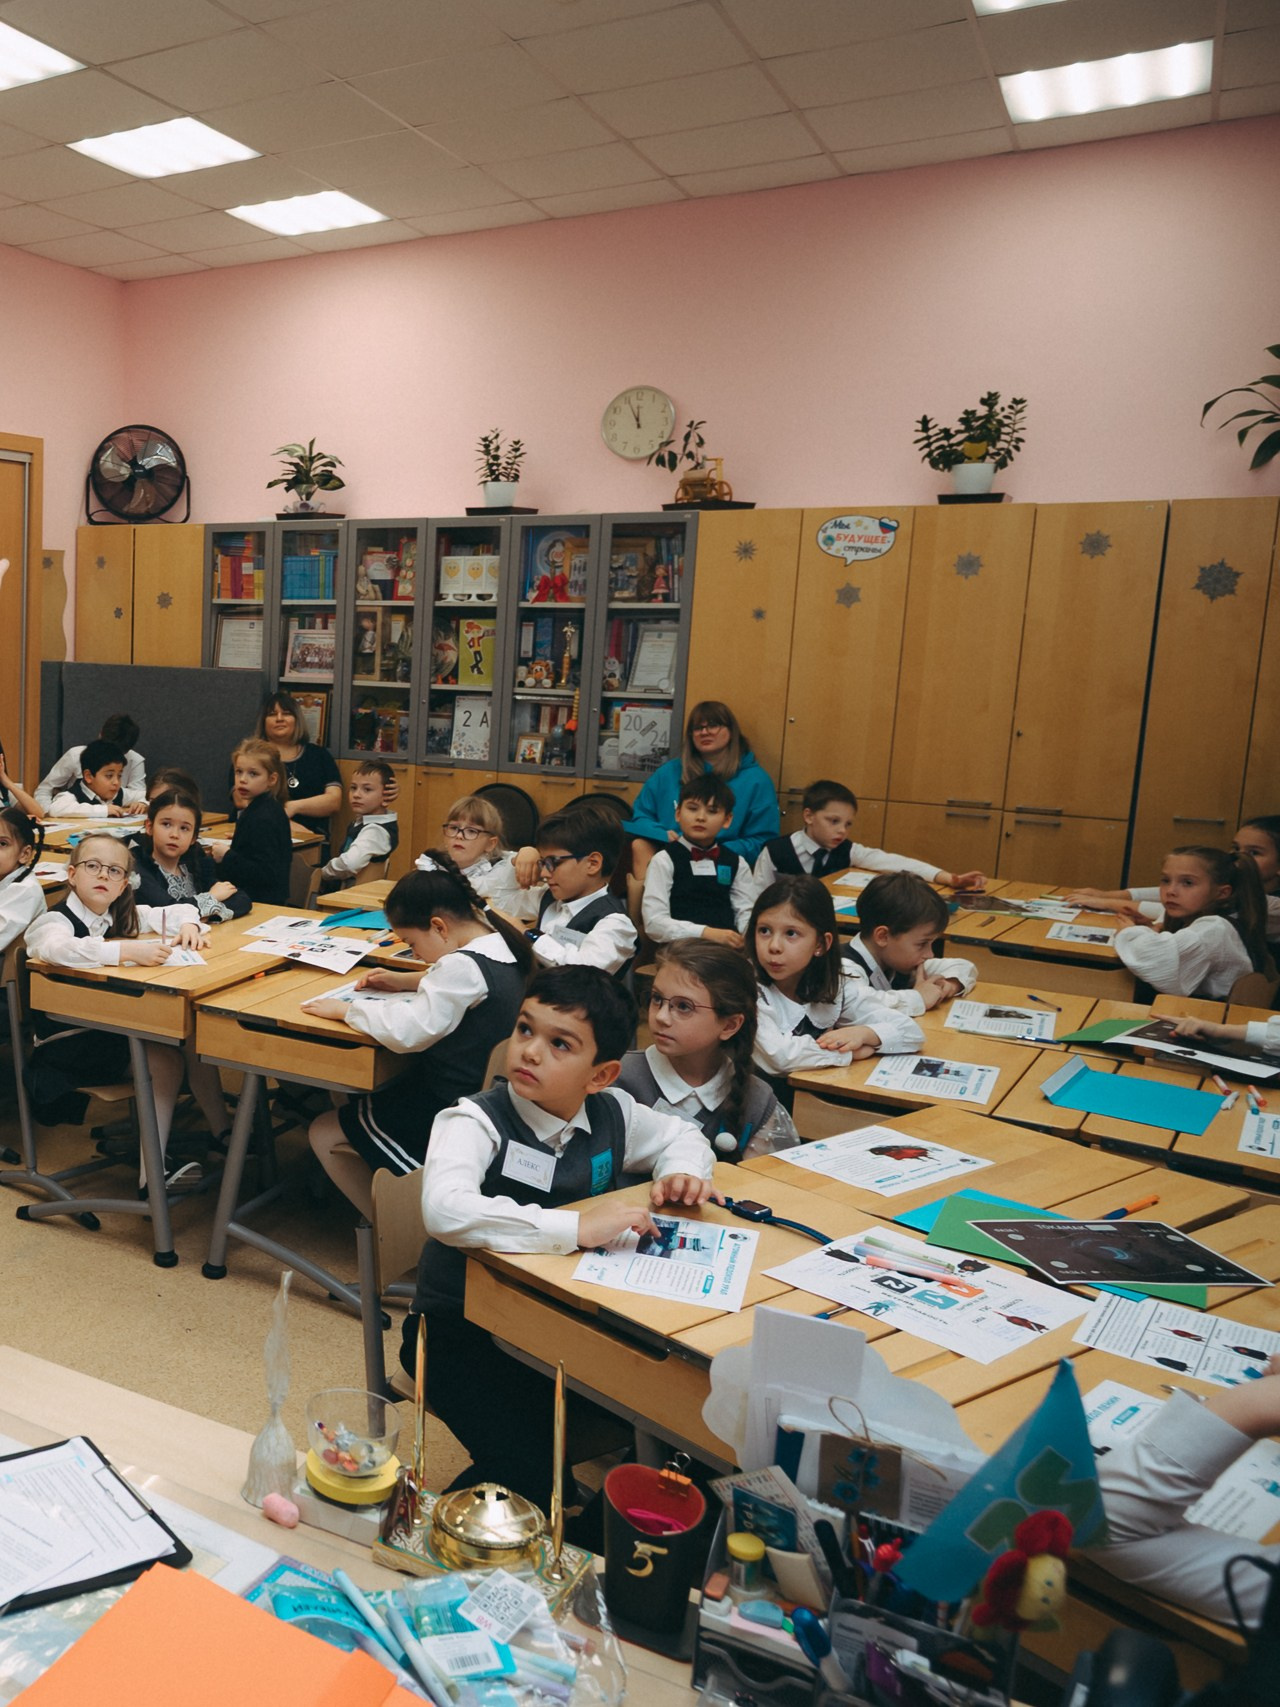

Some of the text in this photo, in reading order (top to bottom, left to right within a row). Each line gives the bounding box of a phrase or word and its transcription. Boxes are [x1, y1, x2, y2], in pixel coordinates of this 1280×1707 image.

[835, 533, 888, 545] БУДУЩЕЕ
[462, 710, 472, 727] 2
[623, 714, 642, 731] 20
[650, 730, 669, 747] 24
[517, 1158, 541, 1172] АЛЕКС
[881, 1279, 905, 1289] 2
[741, 1502, 754, 1529] ТРО
